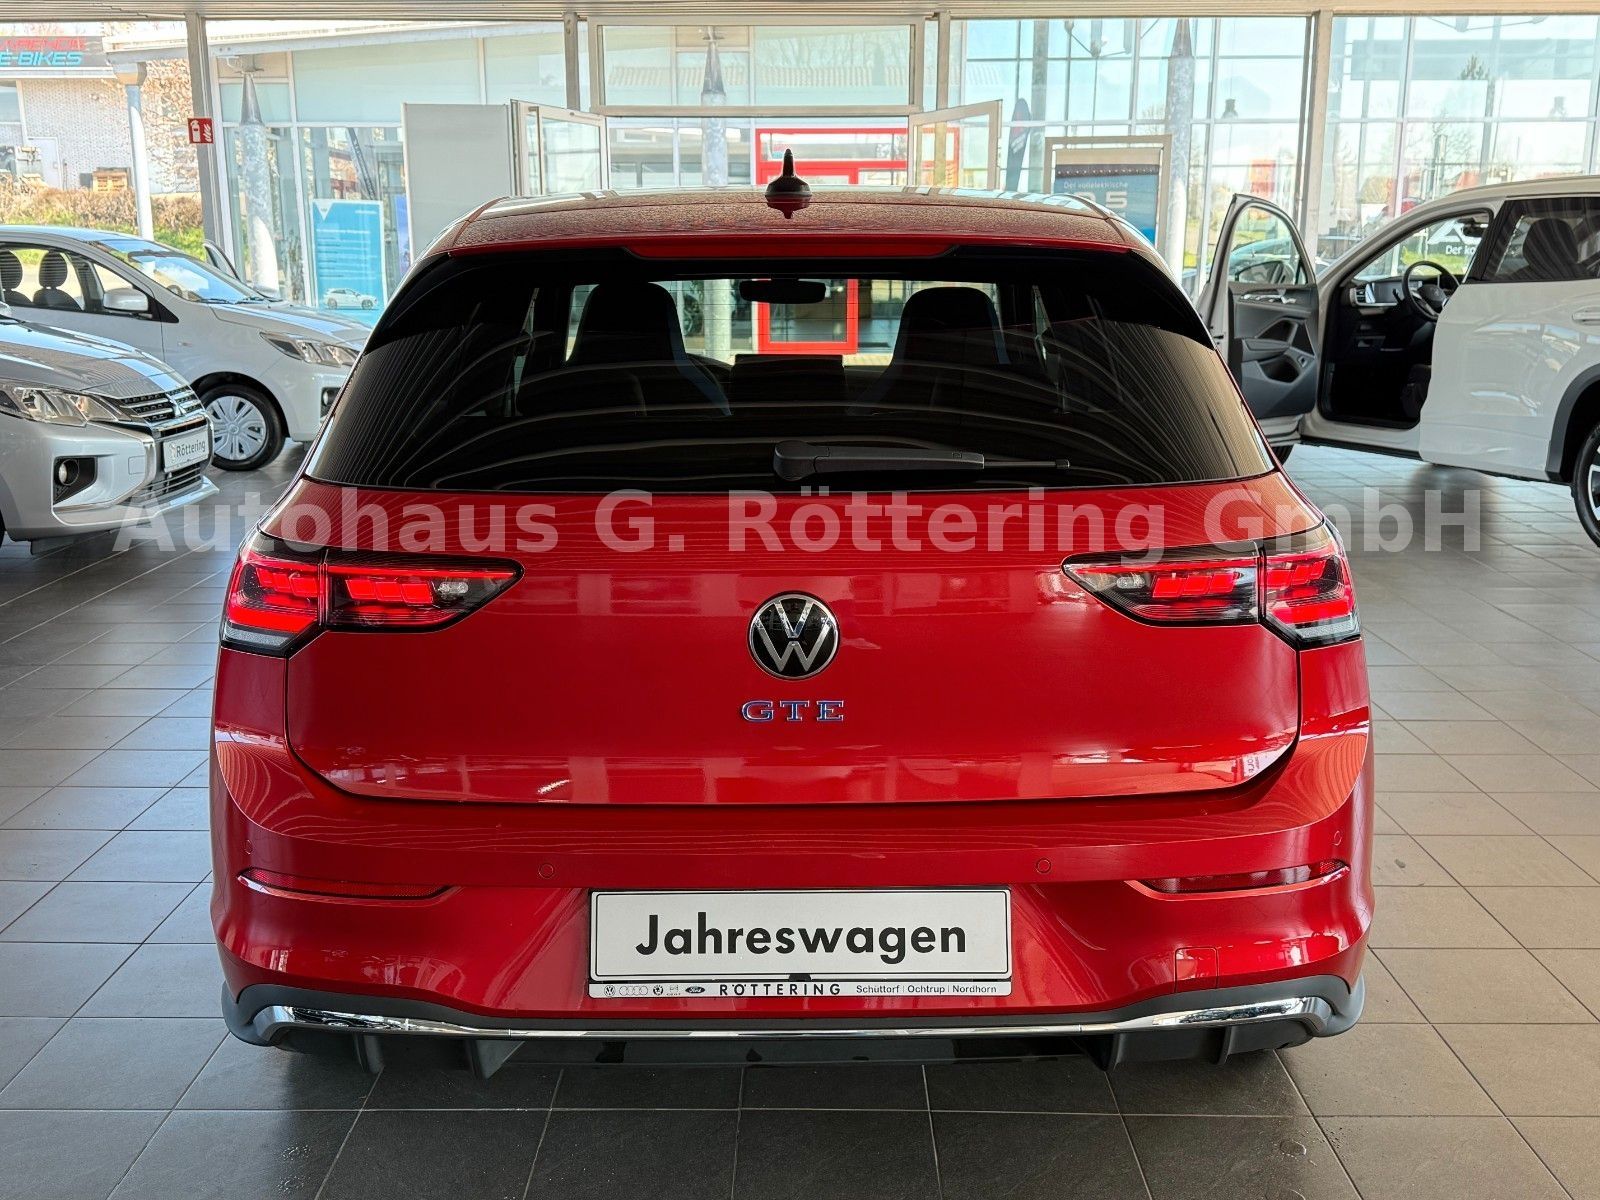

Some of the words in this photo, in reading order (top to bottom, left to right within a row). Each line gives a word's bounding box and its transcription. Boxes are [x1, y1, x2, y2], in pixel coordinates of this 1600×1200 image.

[0, 51, 83, 66] E-BIKES
[1445, 245, 1462, 255] Der
[176, 440, 206, 458] Röttering
[741, 699, 845, 722] GTE
[635, 911, 966, 964] Jahreswagen
[719, 983, 841, 996] RÖTTERING
[856, 985, 900, 994] Schüttorf
[907, 985, 946, 995] Ochtrup
[952, 985, 997, 994] Nordhorn
